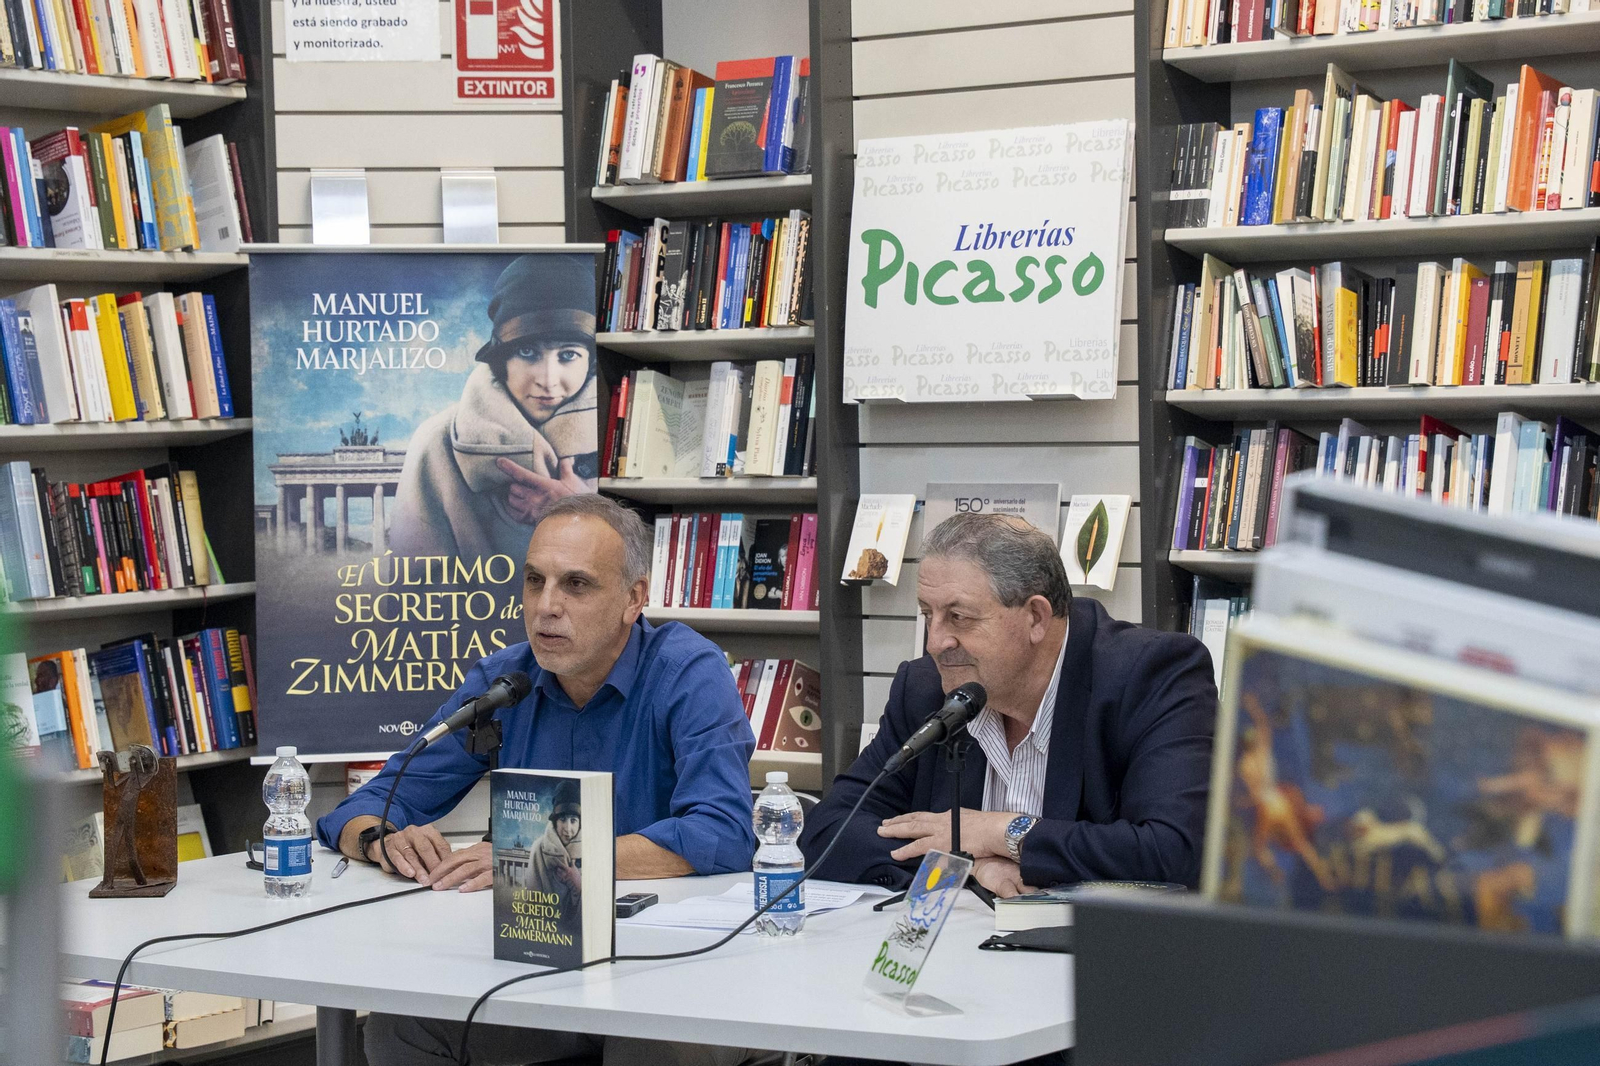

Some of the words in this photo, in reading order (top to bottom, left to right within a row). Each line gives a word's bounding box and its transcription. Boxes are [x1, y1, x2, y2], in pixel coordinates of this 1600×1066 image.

[149, 12, 158, 38] CAMUS
[293, 17, 317, 27] está
[320, 17, 357, 27] siendo
[361, 17, 408, 30] grabado
[224, 27, 236, 48] CELA
[293, 40, 300, 50] y
[303, 38, 384, 48] monitorizado.
[155, 40, 163, 68] ALBERT
[183, 47, 191, 69] ALBERT
[463, 80, 548, 96] EXTINTOR
[635, 88, 643, 120] proverbios
[989, 138, 1053, 159] Picasso
[1066, 132, 1122, 153] Picass
[913, 143, 976, 165] Picasso
[862, 176, 924, 198] Picasso
[936, 171, 1000, 193] Picasso
[1012, 166, 1077, 188] Picasso
[952, 219, 1076, 252] Librerías
[860, 228, 1105, 309] Picasso
[312, 293, 429, 315] MANUEL
[206, 305, 216, 335] MAINER
[1326, 303, 1334, 335] POESÍA
[302, 320, 439, 342] HURTADO
[296, 347, 446, 375] MARJALIZO
[891, 345, 954, 366] Picasso
[966, 342, 1031, 365] Picasso
[1044, 340, 1110, 363] Picasso
[15, 347, 26, 382] CARTAS
[916, 375, 980, 396] Picasso
[992, 373, 1057, 396] Picasso
[753, 447, 761, 464] Plath
[337, 562, 374, 587] El
[373, 550, 515, 587] ÚLTIMO
[334, 591, 495, 624] SECRETO
[501, 596, 523, 620] de
[226, 629, 244, 672] MADRID
[347, 623, 507, 664] MATÍAS
[504, 801, 540, 812] HURTADO
[507, 790, 537, 802] MANUEL
[503, 810, 542, 823] MARJALIZO
[521, 887, 559, 905] ÚLTIMO
[512, 902, 554, 918] SECRETO
[500, 923, 573, 946] ZIMMERMANN
[515, 916, 557, 933] MATÍAS
[871, 940, 918, 986] Picasso
